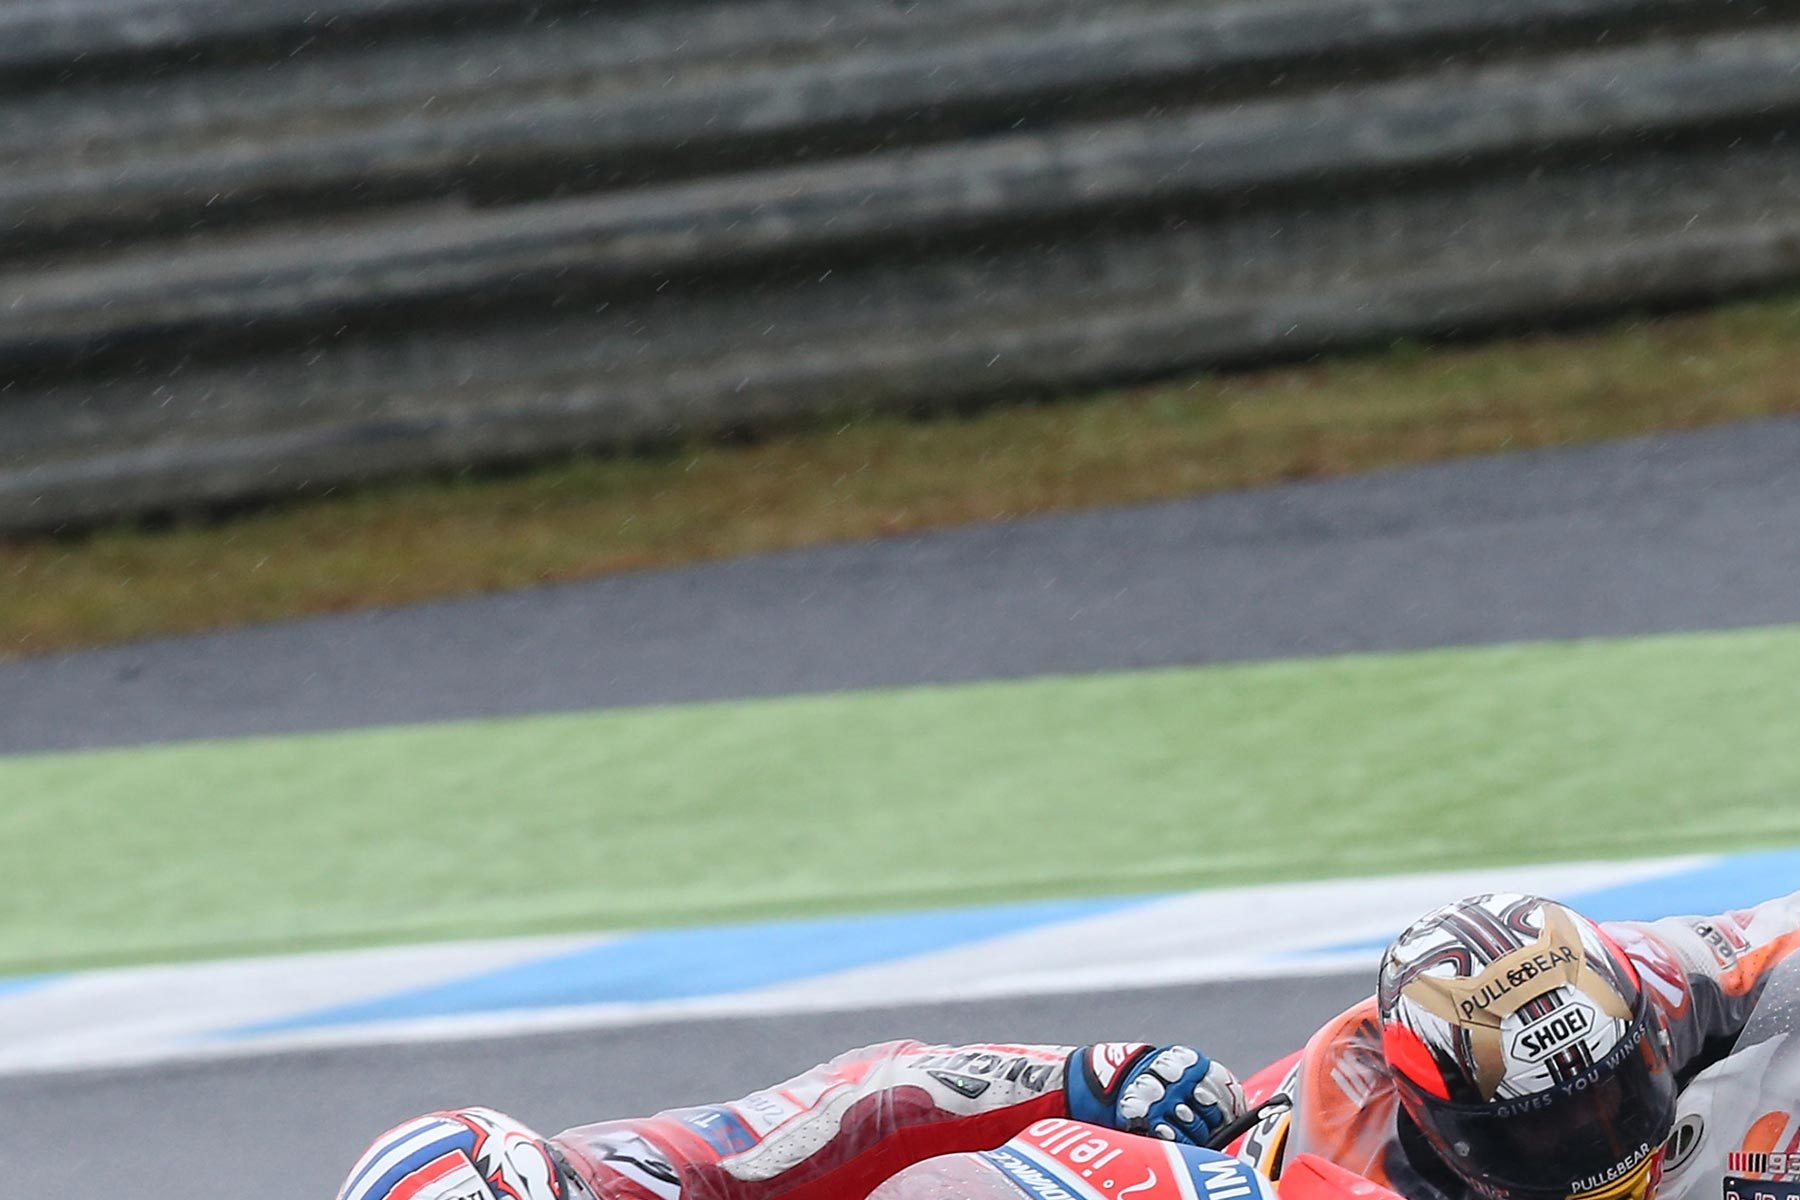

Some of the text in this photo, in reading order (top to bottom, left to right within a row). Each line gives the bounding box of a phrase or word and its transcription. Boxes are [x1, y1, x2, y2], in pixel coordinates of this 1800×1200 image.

[1521, 1008, 1589, 1058] SHOEI
[1562, 1069, 1600, 1097] YOU
[1571, 1142, 1650, 1194] PULL&BEAR
